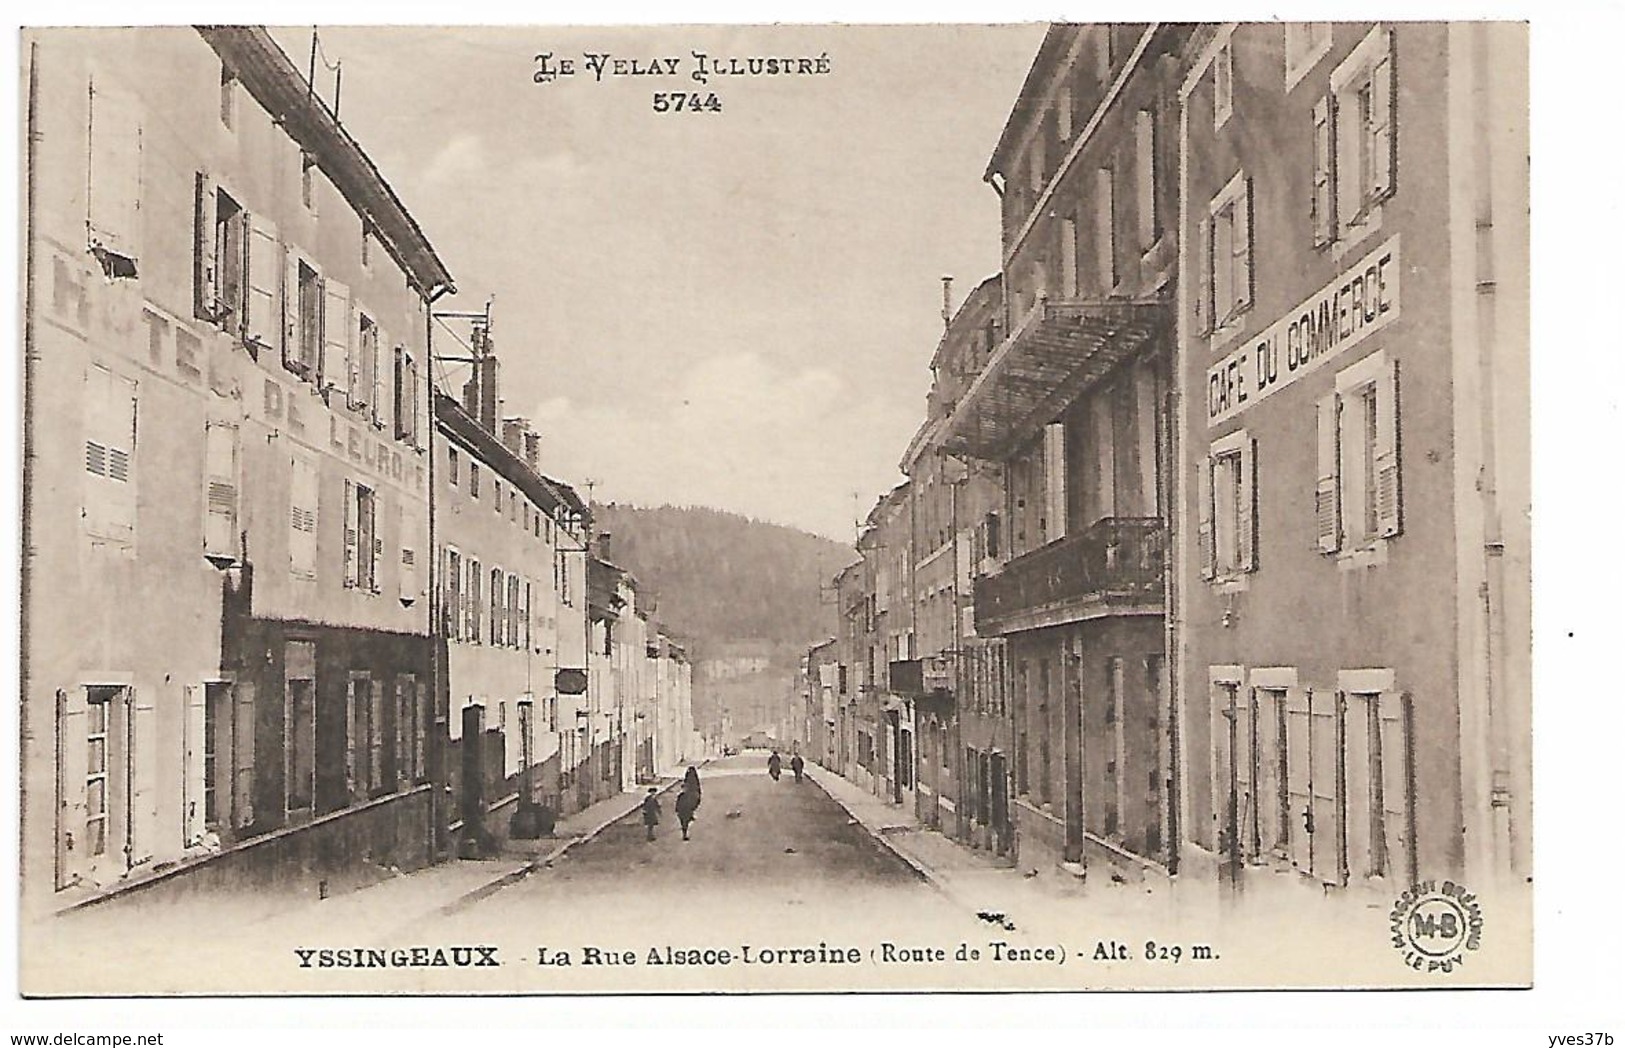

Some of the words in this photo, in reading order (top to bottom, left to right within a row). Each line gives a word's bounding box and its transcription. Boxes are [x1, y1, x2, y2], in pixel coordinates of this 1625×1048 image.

[1210, 354, 1248, 418] CAFE
[1256, 333, 1278, 392] DU
[1287, 252, 1392, 372] COMMERCE
